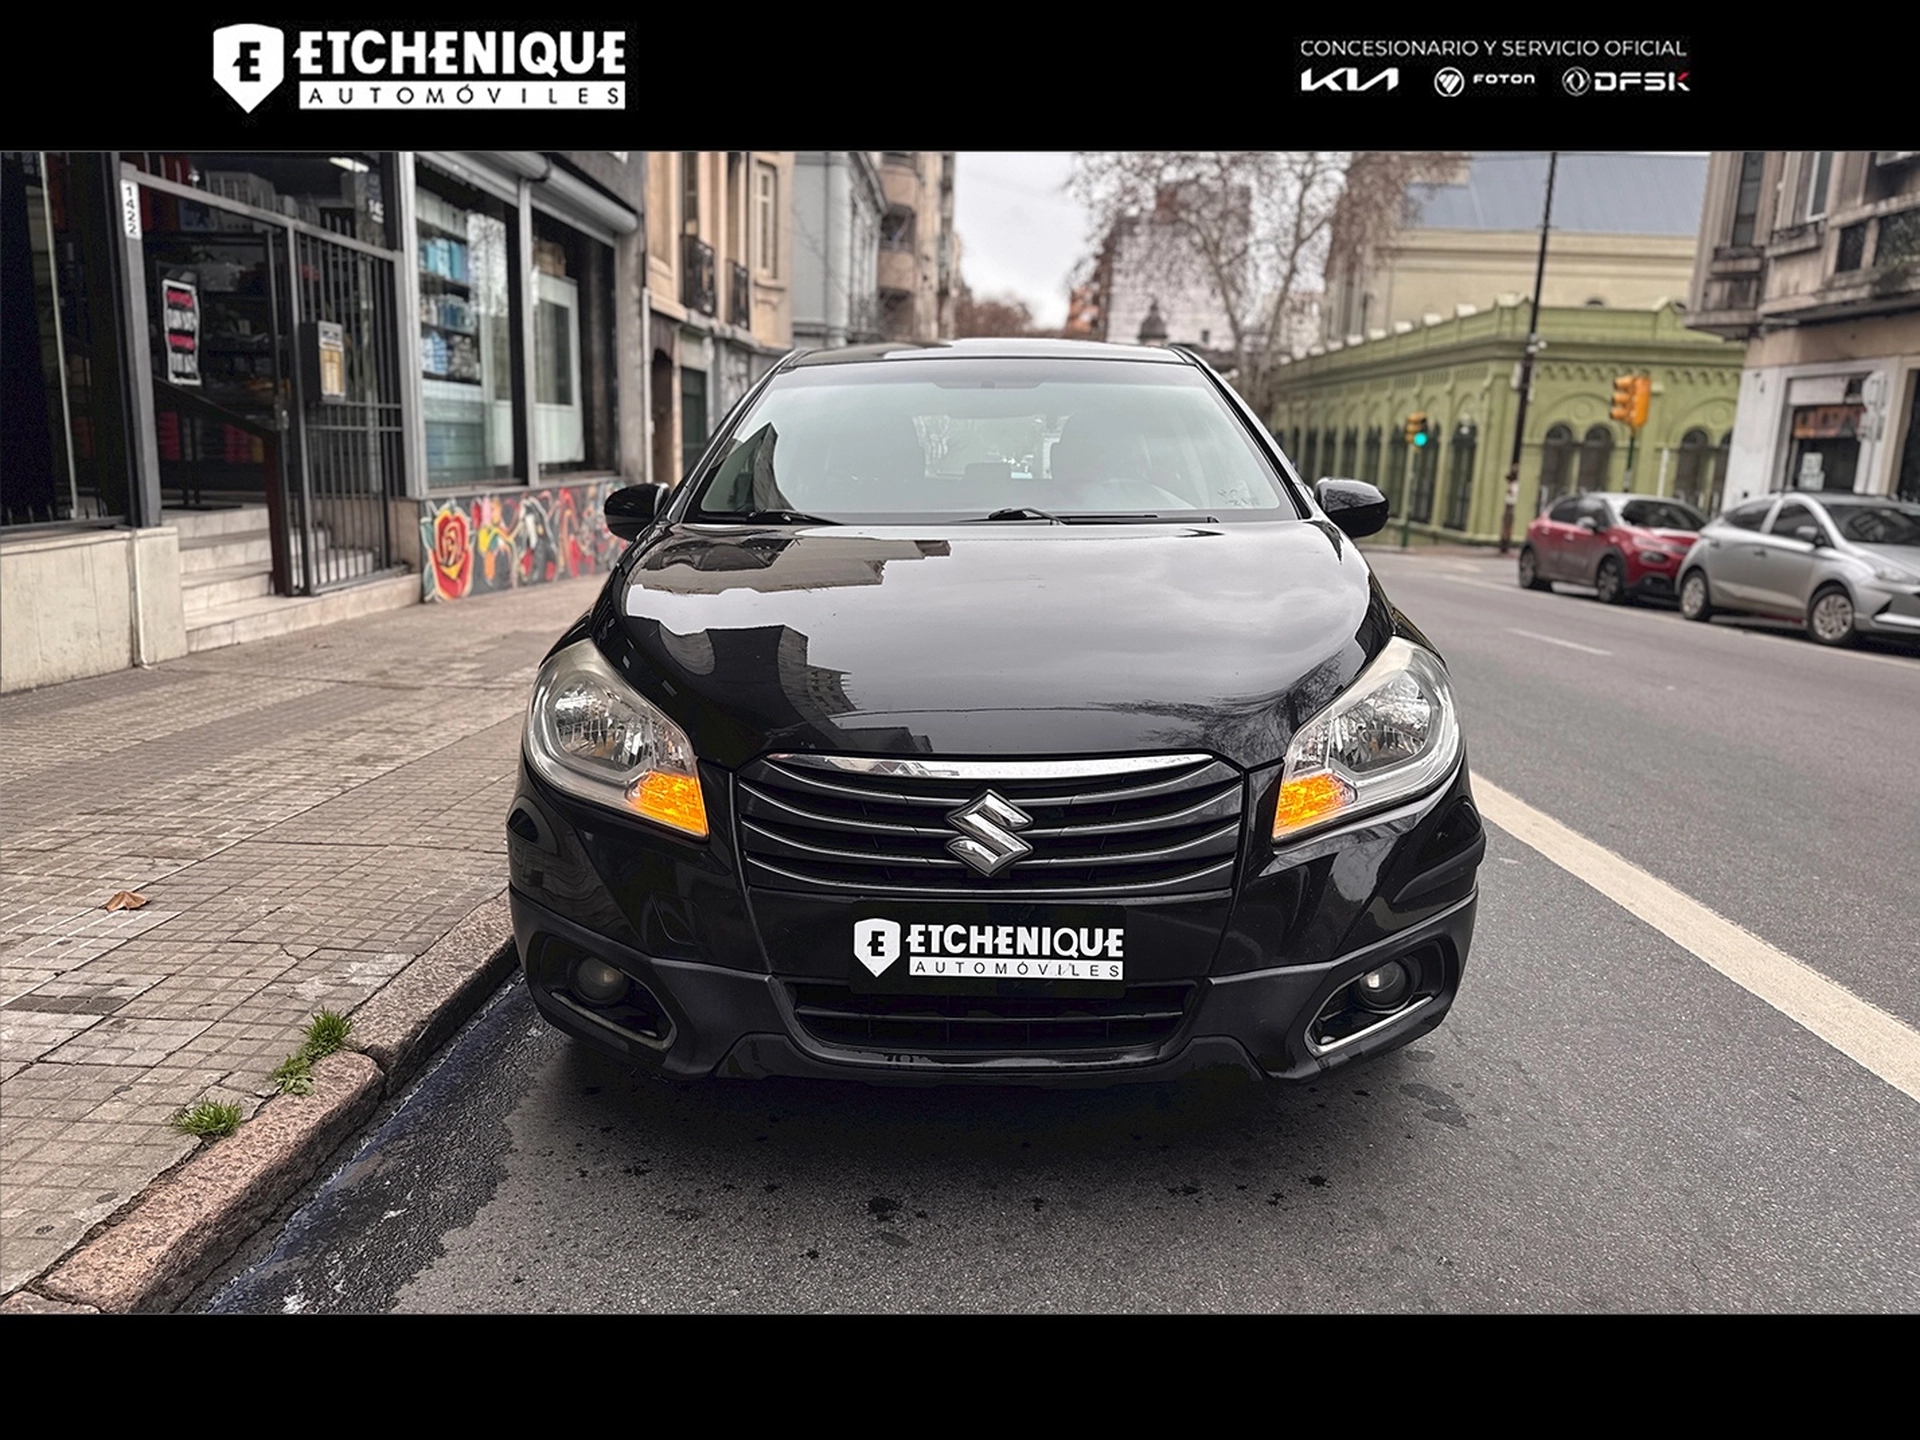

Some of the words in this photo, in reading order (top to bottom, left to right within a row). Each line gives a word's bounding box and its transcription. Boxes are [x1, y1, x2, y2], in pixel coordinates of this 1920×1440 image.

[125, 186, 136, 235] 1422
[905, 924, 1124, 959] ETCHENIQUE
[914, 961, 1120, 978] AUTOMÓVILES
